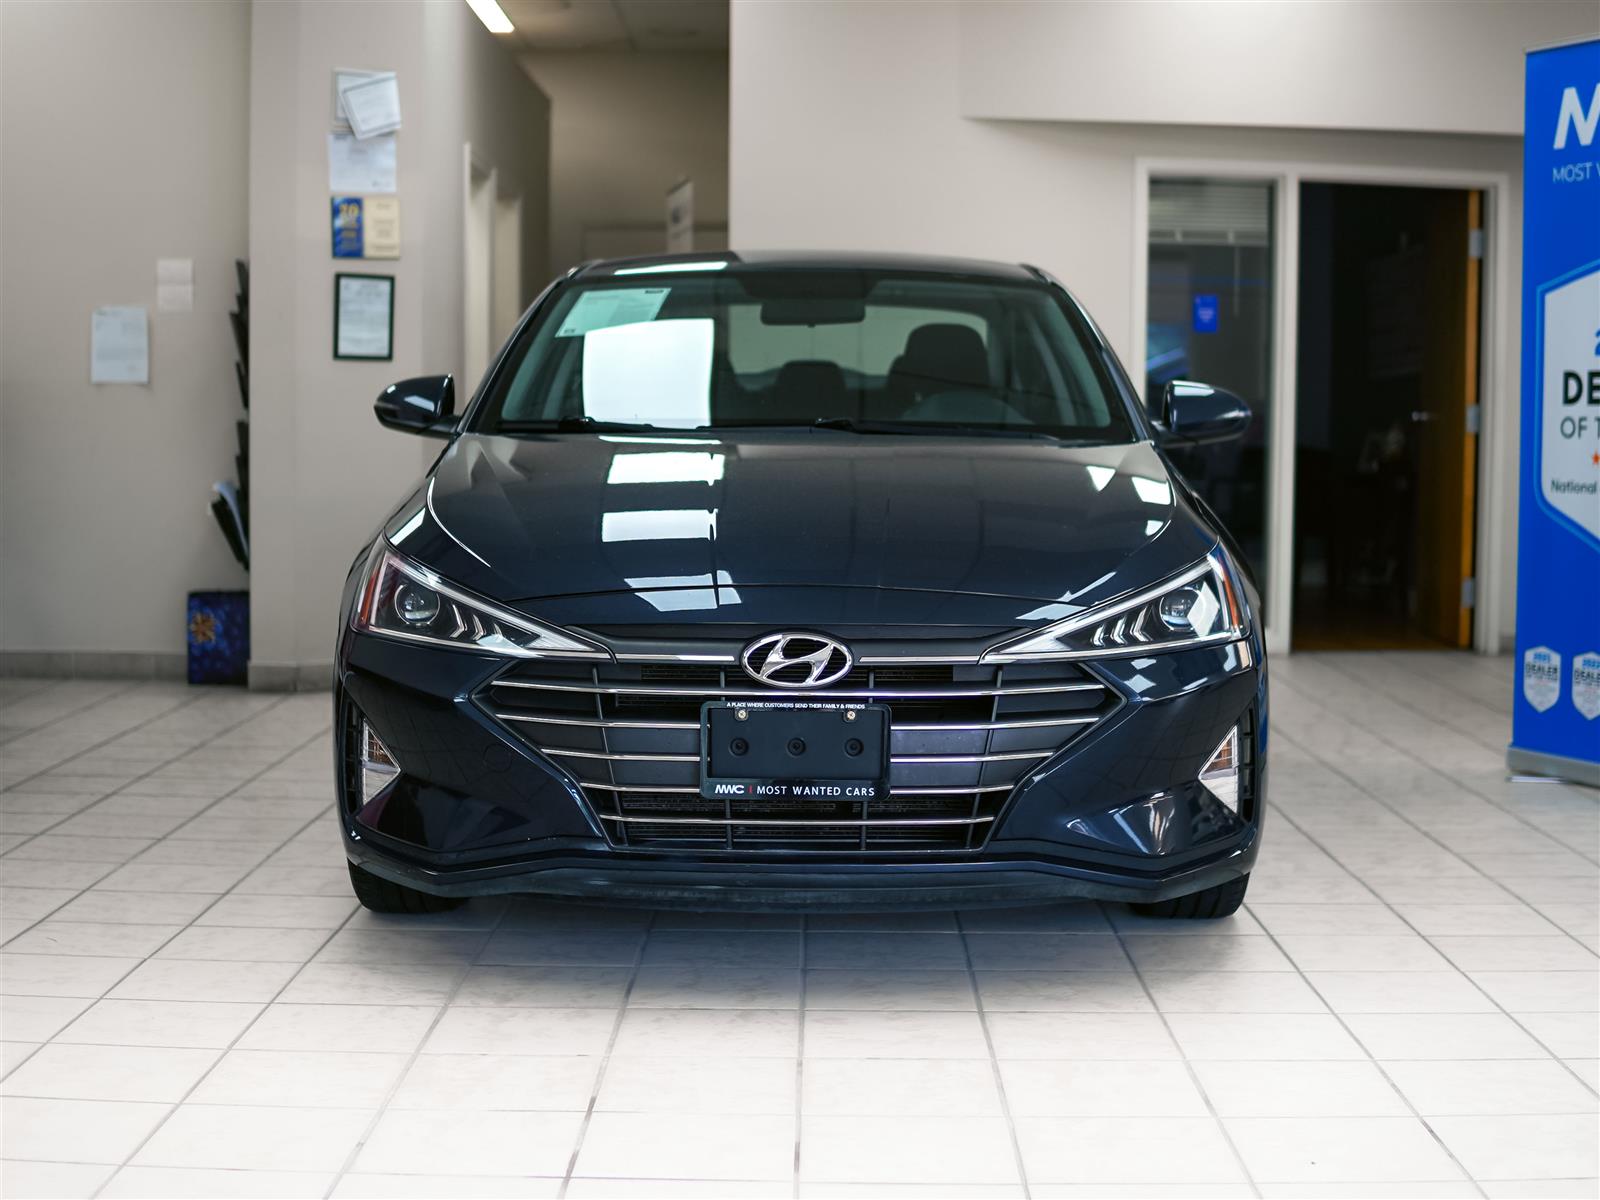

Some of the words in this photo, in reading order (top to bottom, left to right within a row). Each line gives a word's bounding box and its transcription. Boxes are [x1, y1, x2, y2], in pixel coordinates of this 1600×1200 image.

[1552, 161, 1593, 183] MOST
[1560, 416, 1588, 440] OF
[1551, 479, 1597, 494] National
[1525, 662, 1558, 674] DEALER
[714, 784, 745, 794] MWC
[756, 785, 788, 795] MOST
[792, 786, 841, 796] WANTED
[846, 787, 875, 796] CARS
